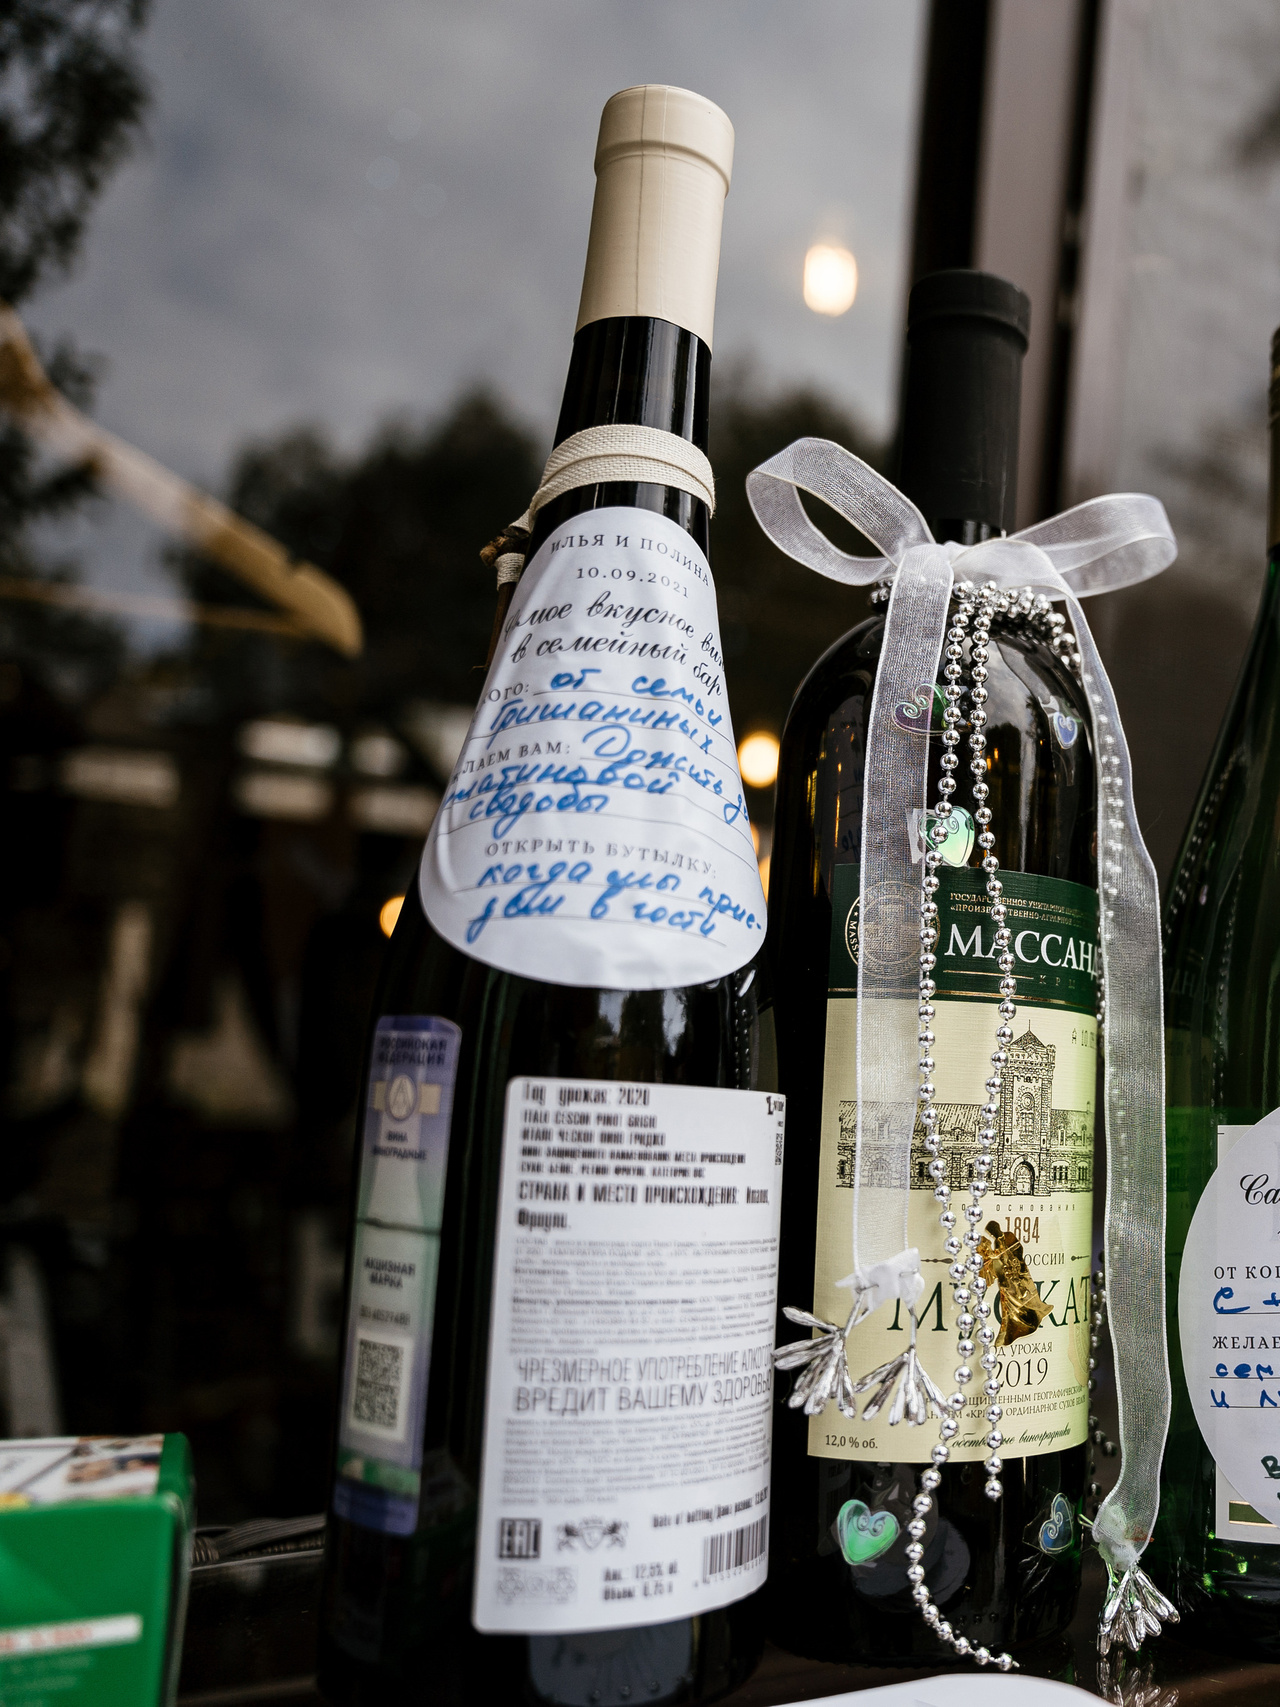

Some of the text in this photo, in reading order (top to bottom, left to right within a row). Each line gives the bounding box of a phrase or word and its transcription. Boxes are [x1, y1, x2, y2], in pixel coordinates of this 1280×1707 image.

[551, 534, 711, 587] ИЛЬЯ И ПОЛИНА
[576, 566, 690, 599] 10.09.2021
[587, 590, 695, 638] вкусное
[511, 631, 721, 697] в семейный бар
[483, 682, 530, 705] ОГО:
[519, 742, 571, 759] ВАМ:
[486, 838, 717, 879] ОТКРЫТЬ БУТЫЛКУ:
[950, 892, 1027, 907] ГОСУДАРСВЕННОЕ
[518, 1181, 570, 1202] СТРАНА
[592, 1182, 639, 1204] МЕСТО
[1023, 1253, 1065, 1267] ОССИИ
[1213, 1266, 1237, 1280] ОТ
[994, 1341, 1053, 1357] ОД УРОЖАЯ
[517, 1350, 739, 1383] ЧРЕЗМЕРНОЕ УПОТРЕБЛЕНИЕ
[997, 1358, 1048, 1388] 2019
[516, 1386, 611, 1416] ВРЕДИТ
[618, 1382, 709, 1411] ВАШЕМУ
[1006, 1402, 1057, 1416] ОРДИНАРНОЕ
[825, 1434, 878, 1449] 12,0 % об.
